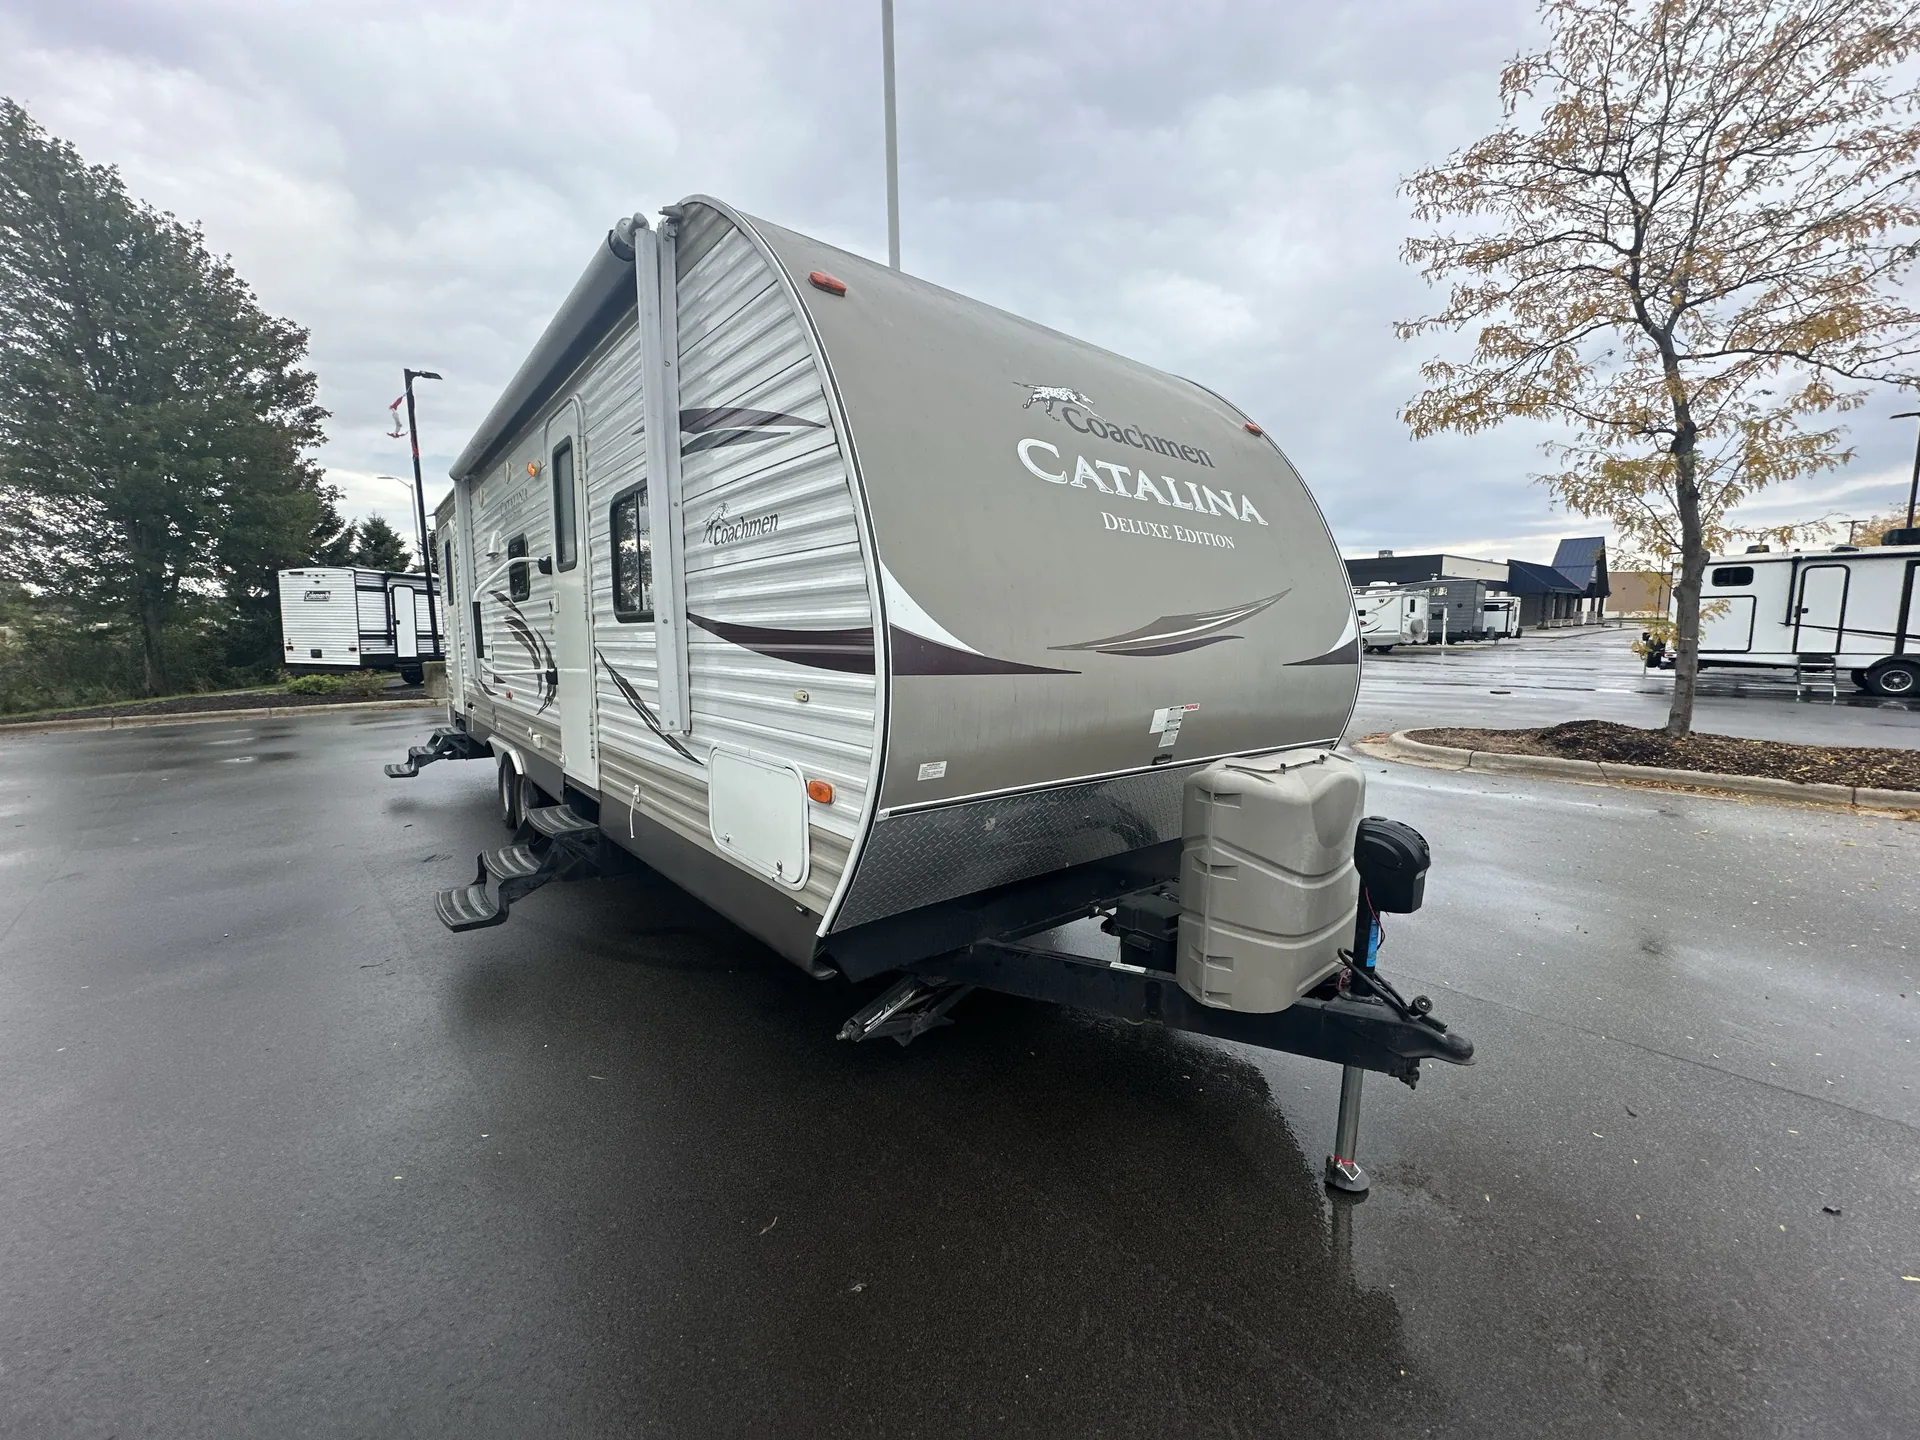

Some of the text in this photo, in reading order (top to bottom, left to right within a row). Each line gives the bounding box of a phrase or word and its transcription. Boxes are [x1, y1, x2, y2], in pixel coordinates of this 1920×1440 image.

[1061, 406, 1216, 469] Coachmen
[1016, 437, 1269, 526] CATALINA
[713, 512, 779, 546] Coachmen
[1100, 511, 1236, 550] DELUXE EDITION
